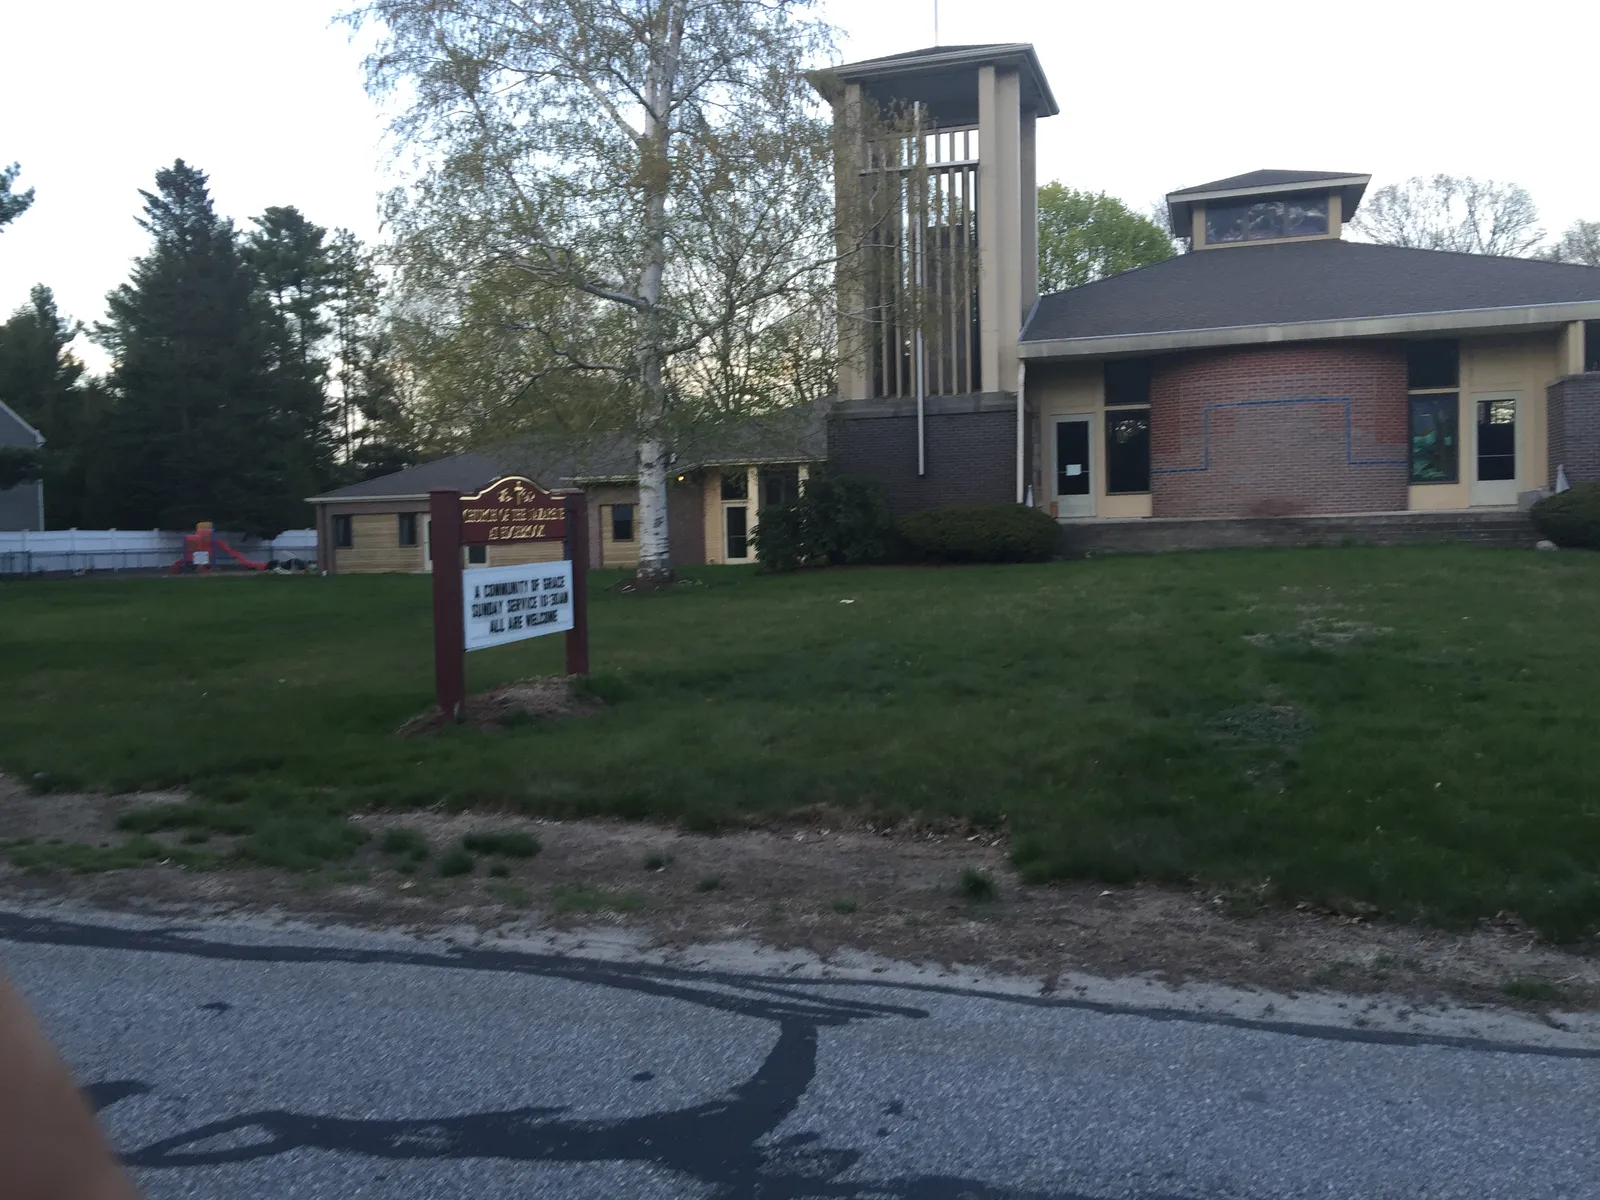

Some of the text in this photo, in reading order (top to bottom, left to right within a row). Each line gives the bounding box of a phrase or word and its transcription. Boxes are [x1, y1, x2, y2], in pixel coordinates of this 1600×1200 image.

[474, 575, 565, 598] A COMMUNITY OF GRACE
[472, 600, 503, 618] SUNDAY
[507, 596, 538, 613] SERVICE
[489, 610, 558, 634] ALL ARE WELCOME
